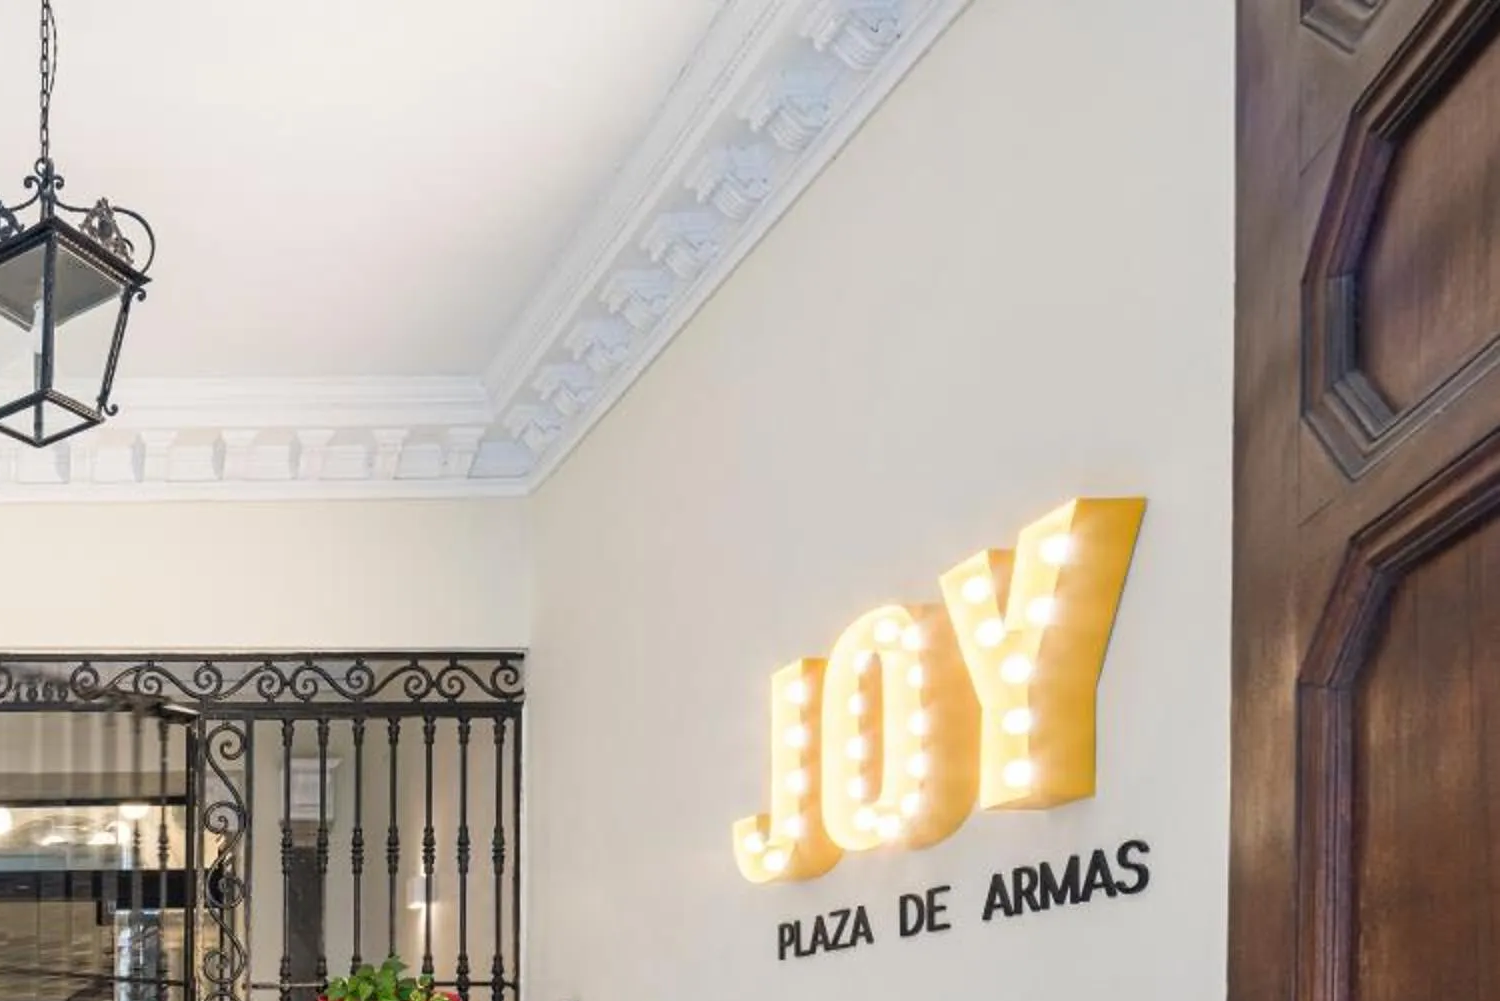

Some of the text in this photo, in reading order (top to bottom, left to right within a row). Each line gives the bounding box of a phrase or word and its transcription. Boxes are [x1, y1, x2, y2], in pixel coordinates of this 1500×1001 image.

[732, 497, 1147, 883] JOY
[778, 840, 1150, 960] PLAZA DE ARMAS
